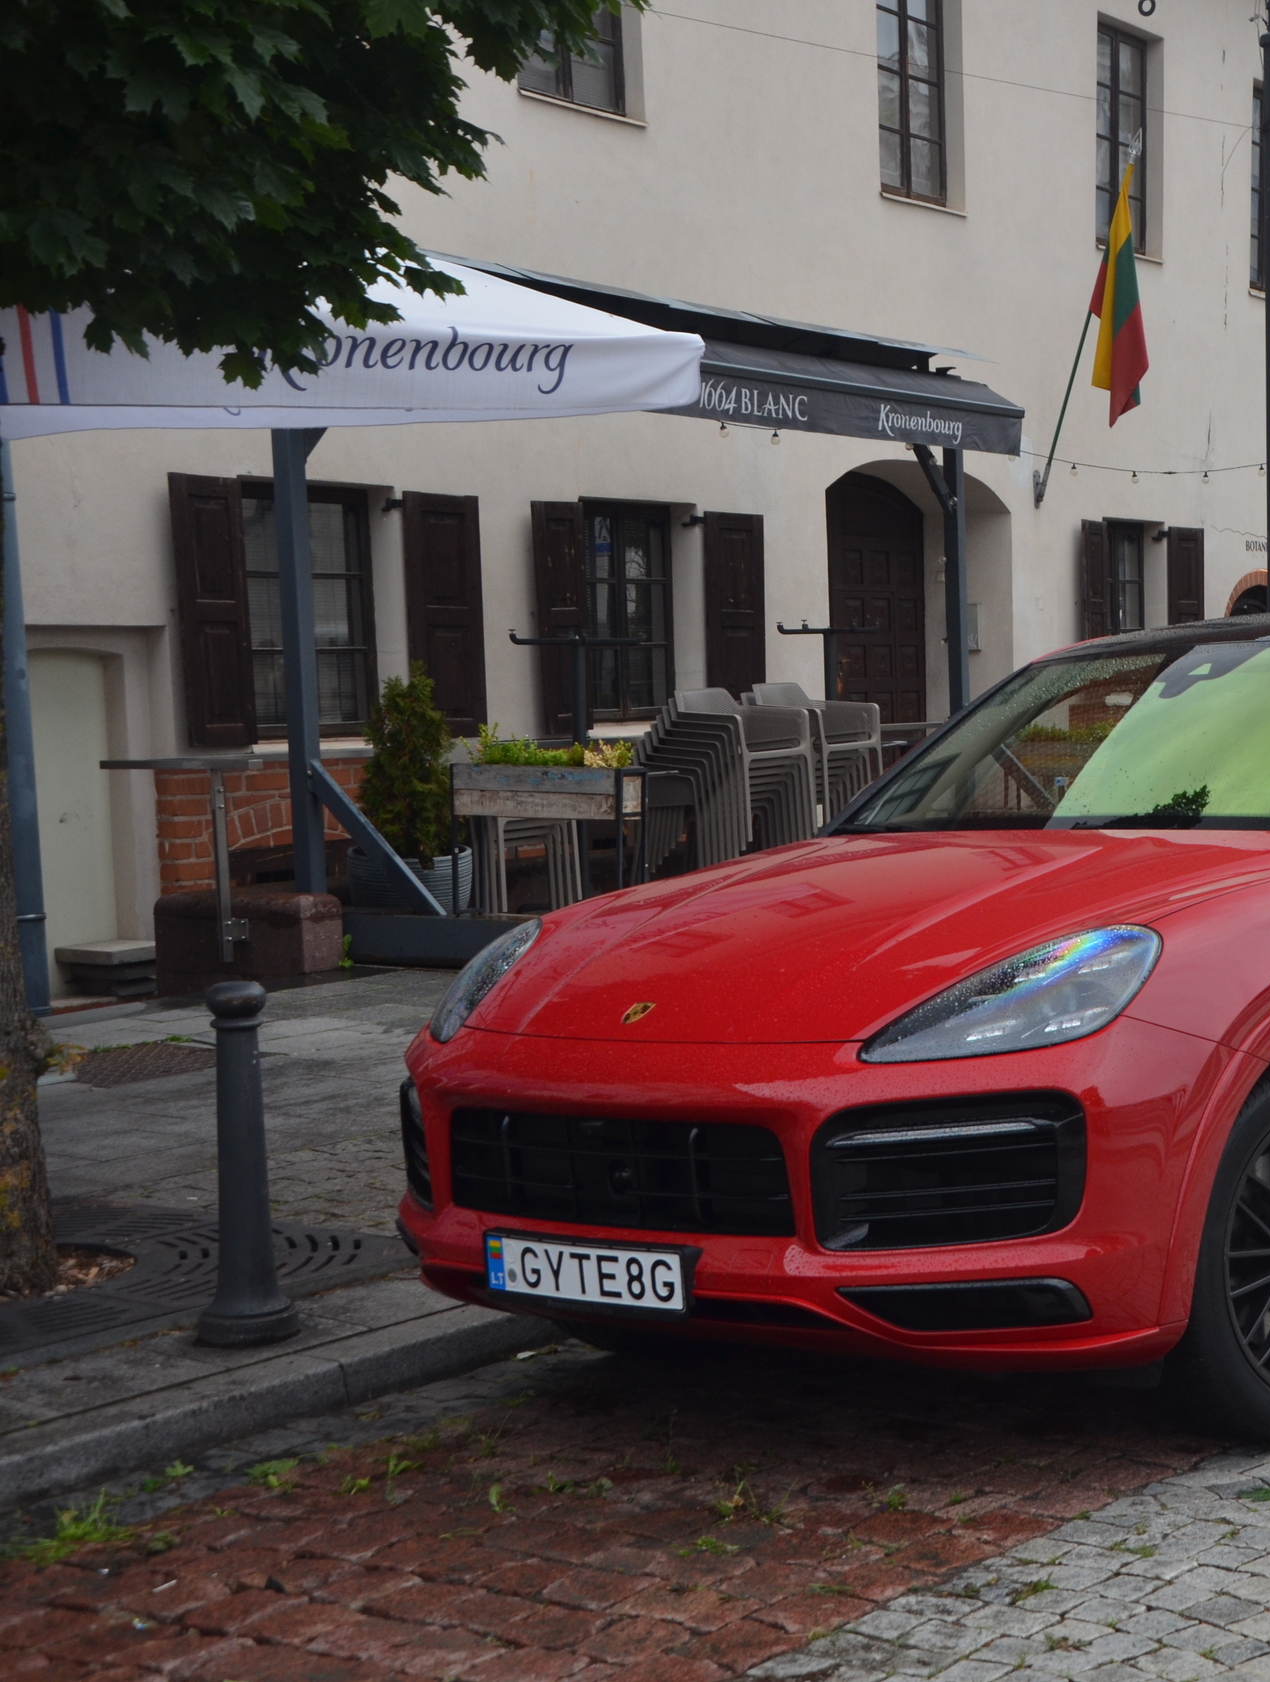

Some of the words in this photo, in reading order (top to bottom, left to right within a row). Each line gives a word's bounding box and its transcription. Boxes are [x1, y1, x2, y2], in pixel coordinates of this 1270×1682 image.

[257, 326, 574, 394] onenbourg
[699, 378, 738, 415] 1664
[740, 387, 808, 421] BLANC
[877, 403, 963, 444] Kronenbourg
[490, 1271, 504, 1285] LT
[520, 1246, 675, 1303] GYTE8G
